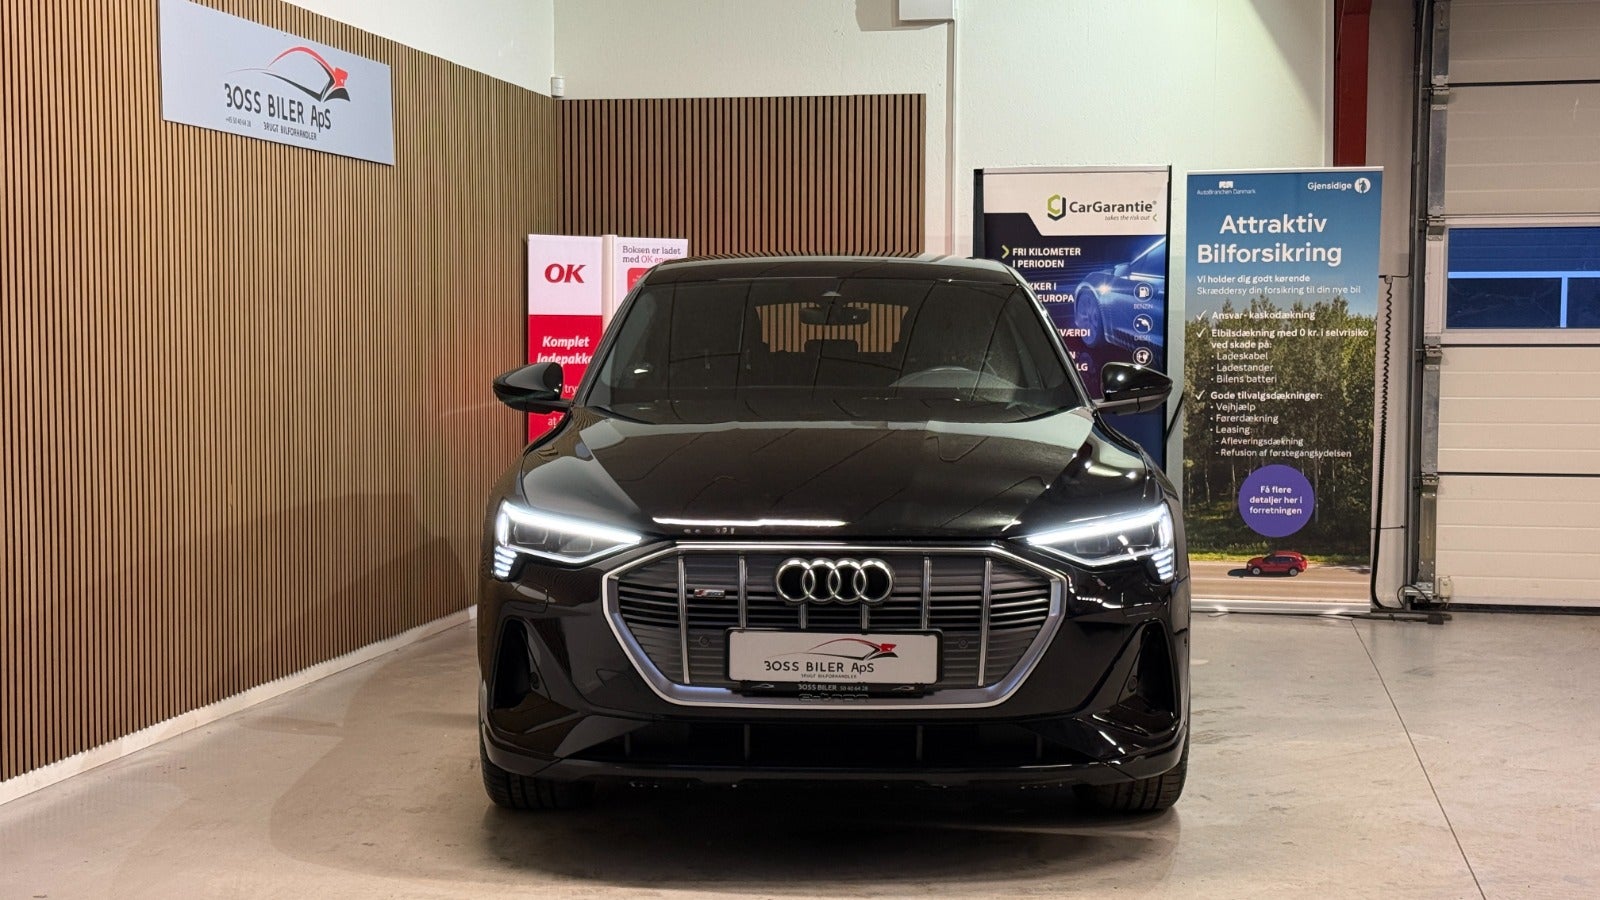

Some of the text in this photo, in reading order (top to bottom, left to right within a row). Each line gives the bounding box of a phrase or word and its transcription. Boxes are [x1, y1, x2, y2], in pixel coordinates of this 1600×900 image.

[268, 94, 304, 124] BILER
[310, 104, 332, 133] ApS
[280, 125, 317, 140] BILFORHANDLER
[1308, 182, 1352, 192] Gjensidige
[1220, 212, 1327, 234] Attraktiv
[622, 246, 650, 254] Boksen
[1012, 248, 1081, 256] FRI KILOMETER
[1197, 242, 1342, 267] Bilforsikring
[1018, 260, 1064, 268] PERIODEN
[544, 263, 586, 284] OK
[1197, 275, 1206, 283] Vi
[1208, 275, 1235, 283] holder
[1237, 275, 1250, 285] dig
[1252, 275, 1273, 285] godt
[1027, 282, 1057, 291] KKER I
[1197, 287, 1247, 296] Skræddersy
[1264, 286, 1304, 295] forsikring
[1332, 287, 1348, 295] nye
[1038, 294, 1075, 302] EUROPA
[1212, 311, 1316, 321] Ansvar- kaskodækning
[1212, 329, 1275, 338] Elbilsdækning
[1277, 329, 1297, 337] med
[1325, 329, 1368, 337] selvrisiko
[542, 336, 590, 350] Komplet
[1211, 341, 1228, 349] ved
[1229, 341, 1256, 349] skade
[1216, 352, 1268, 360] Ladeskabel
[1216, 375, 1277, 383] Bilens batteri
[1210, 392, 1235, 400] Gode
[1216, 403, 1256, 413] Vejhjælp
[1215, 414, 1279, 424] Førerdækning
[1220, 438, 1304, 447] Afleveringsdækning
[1259, 449, 1267, 457] af
[1269, 449, 1352, 459] førstegangsydelsen
[1260, 485, 1271, 493] Få
[1249, 496, 1281, 505] detaljer
[1284, 496, 1298, 504] her
[1249, 507, 1302, 516] forretningen
[806, 662, 844, 672] BILER
[851, 663, 874, 675] ApS
